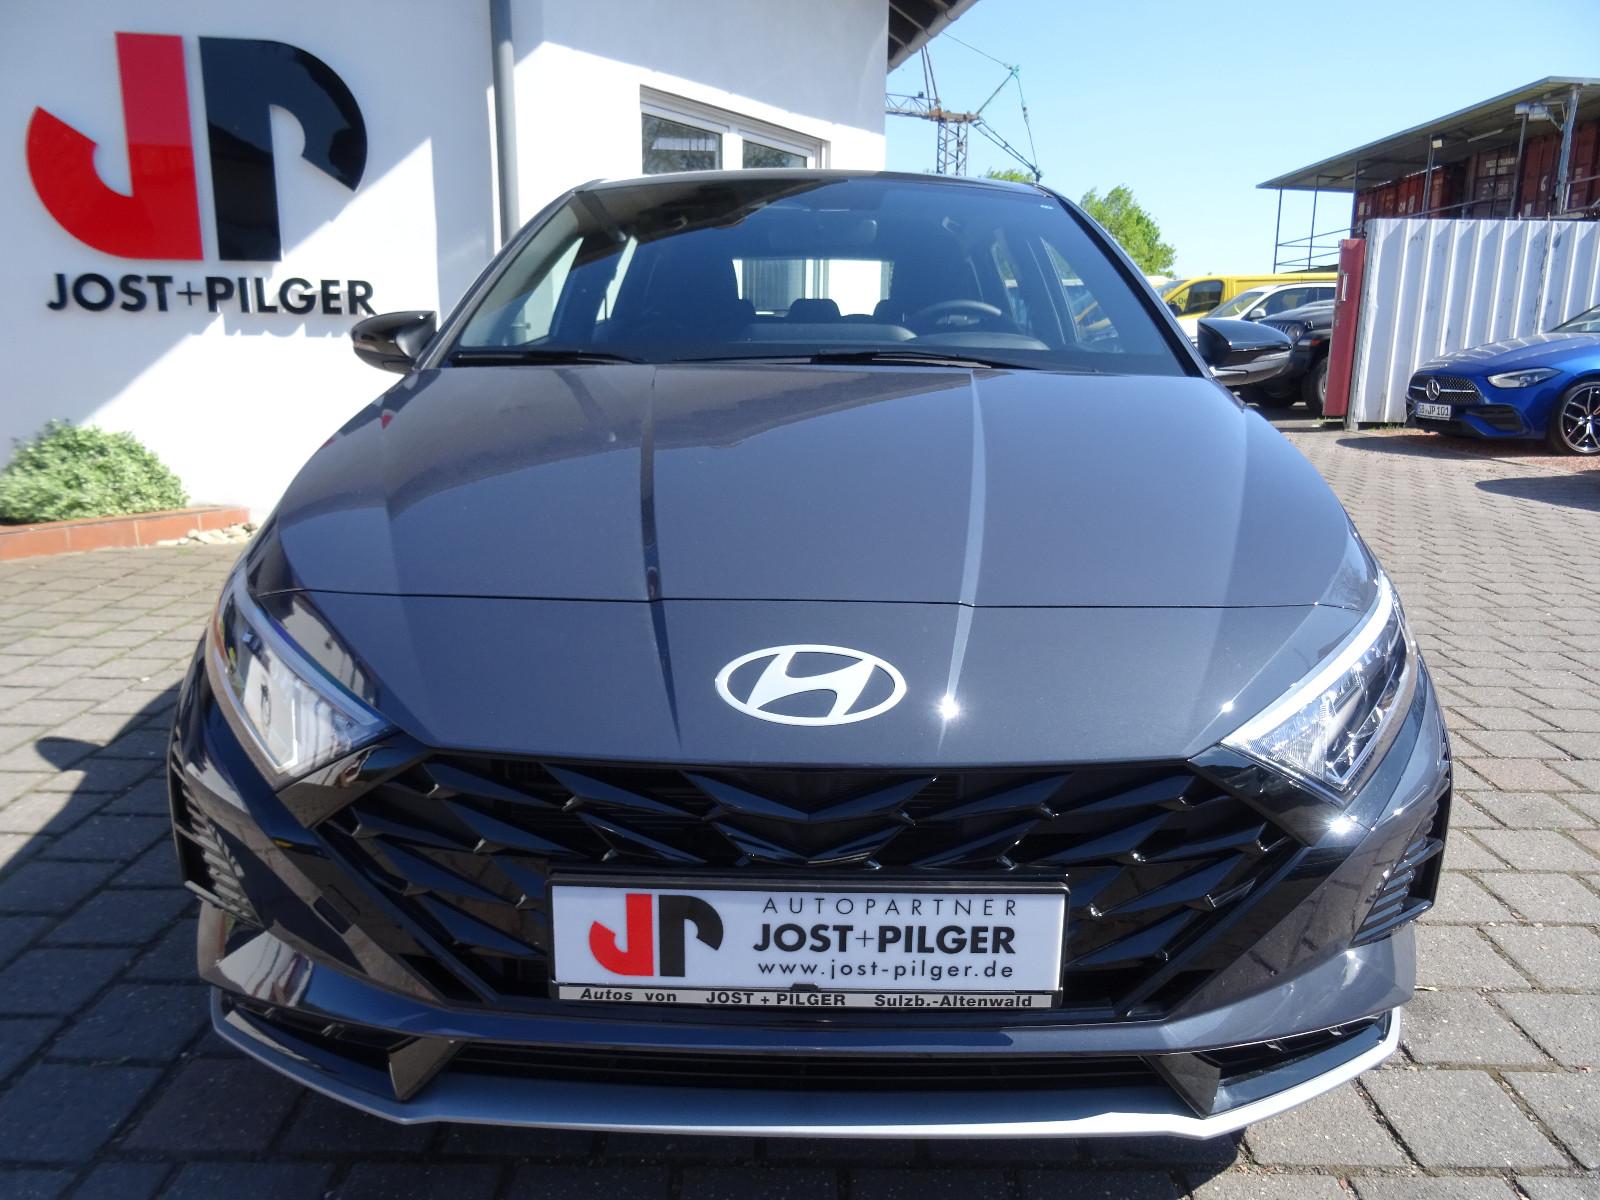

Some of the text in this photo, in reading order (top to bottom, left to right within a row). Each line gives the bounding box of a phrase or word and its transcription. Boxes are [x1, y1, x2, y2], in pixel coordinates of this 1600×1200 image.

[47, 273, 377, 315] JOST+PILGER
[762, 897, 1016, 916] AUTOPARTNER
[753, 923, 1016, 954] JOST+PILGER
[758, 959, 1014, 981] www.jost-pilger.de
[580, 988, 633, 1001] Autos
[645, 991, 677, 1002] von
[706, 991, 754, 1004] JOST
[777, 992, 846, 1006] PILGER
[874, 994, 1033, 1008] Sulzb.-Altenwald
